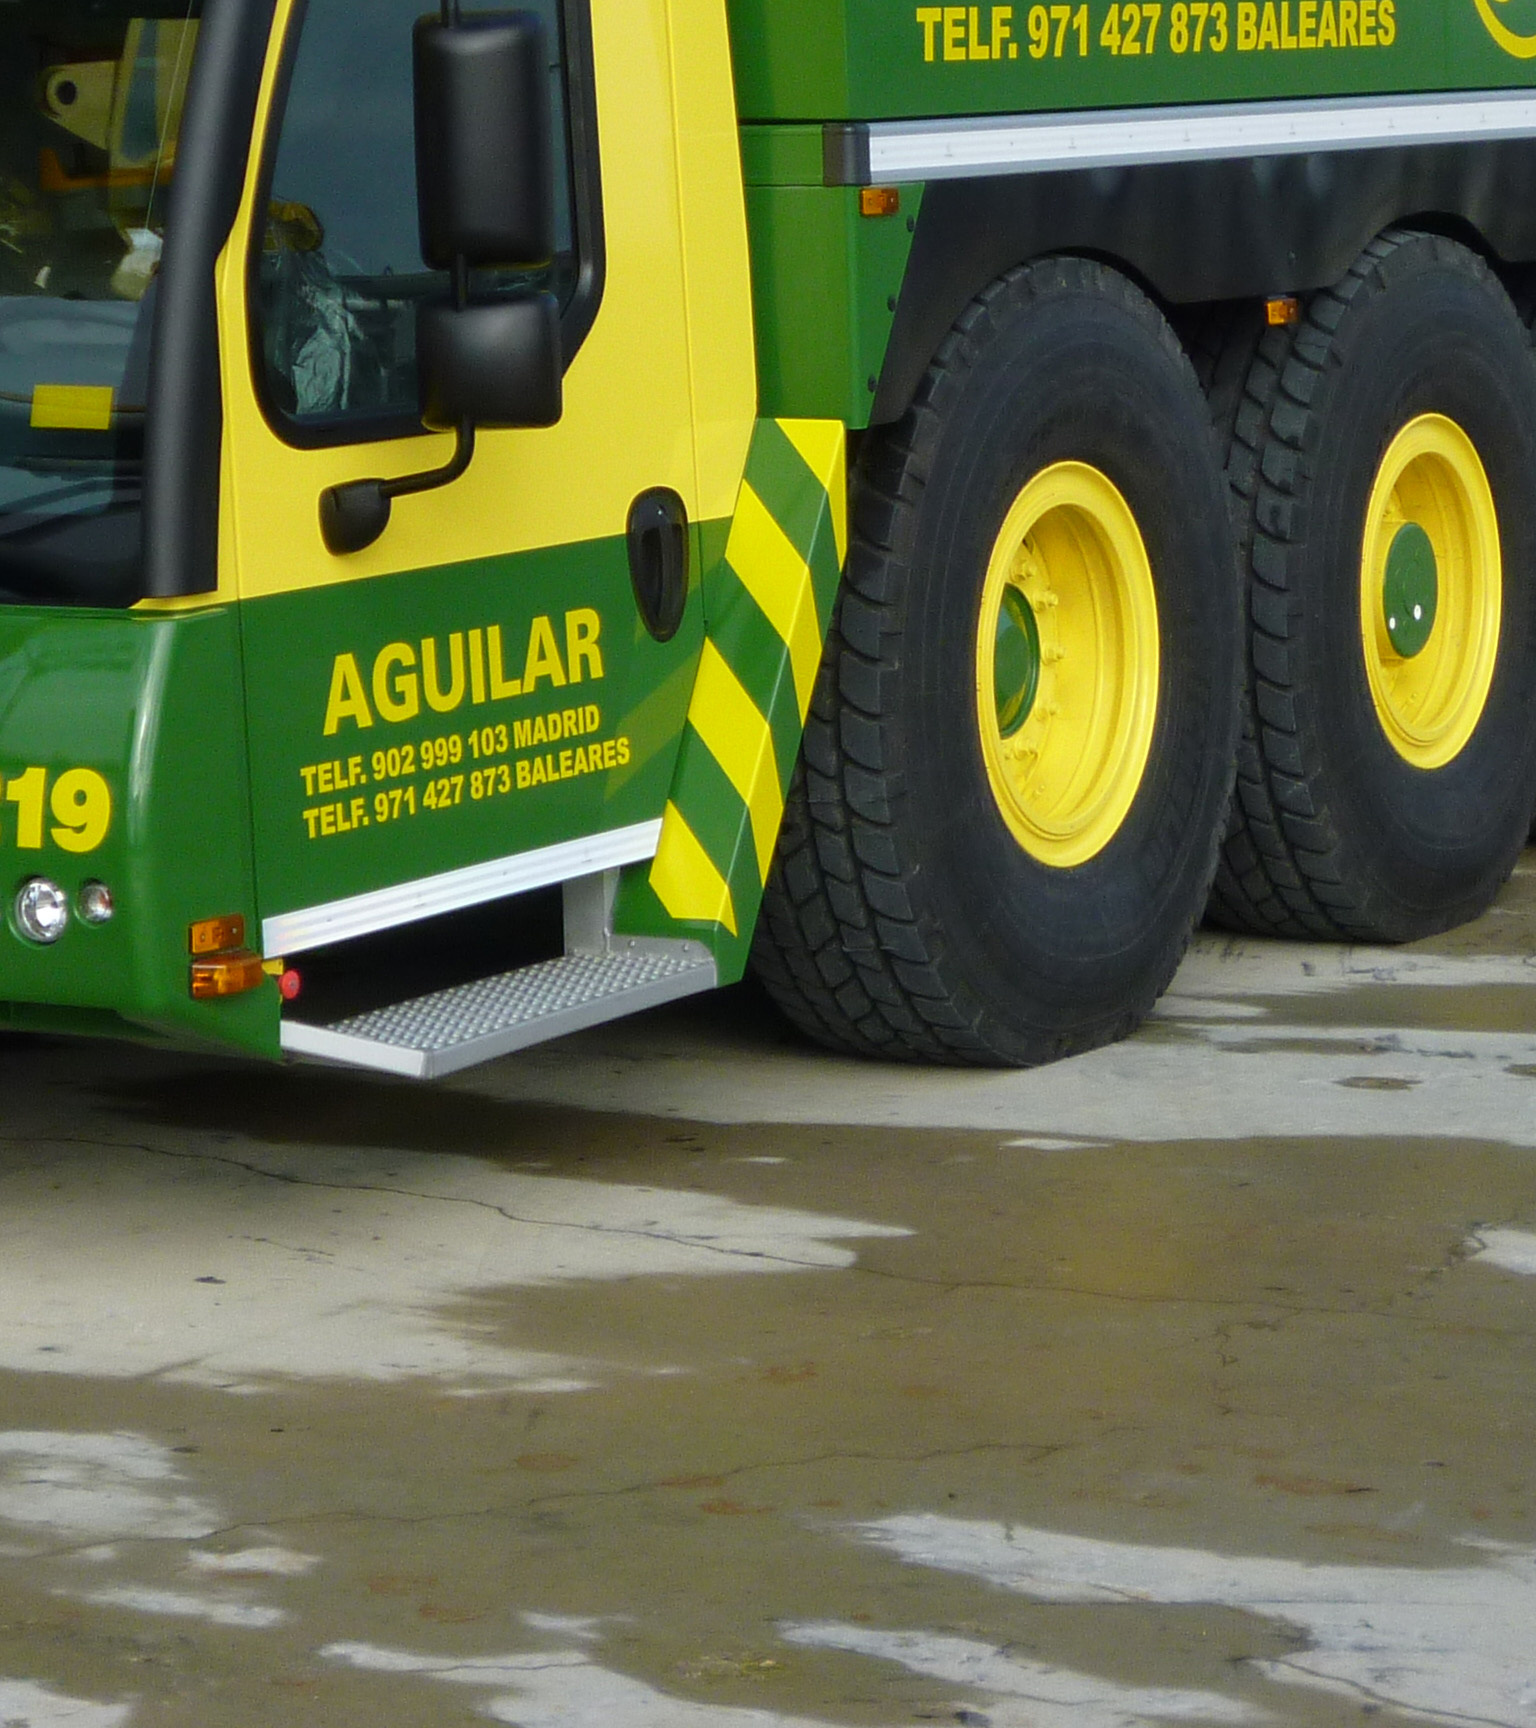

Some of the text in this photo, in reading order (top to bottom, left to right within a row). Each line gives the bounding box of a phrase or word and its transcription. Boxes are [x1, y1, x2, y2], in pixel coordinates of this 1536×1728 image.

[916, 5, 1018, 62] TELF.
[1027, 4, 1089, 59] 971
[1099, 3, 1162, 56] 427
[1169, 2, 1229, 54] 873
[323, 607, 605, 737] AGUILAR
[300, 704, 600, 797] TELF. 902 999 103 MADRID
[302, 736, 631, 839] TELF. 971 427 873 BALEARES
